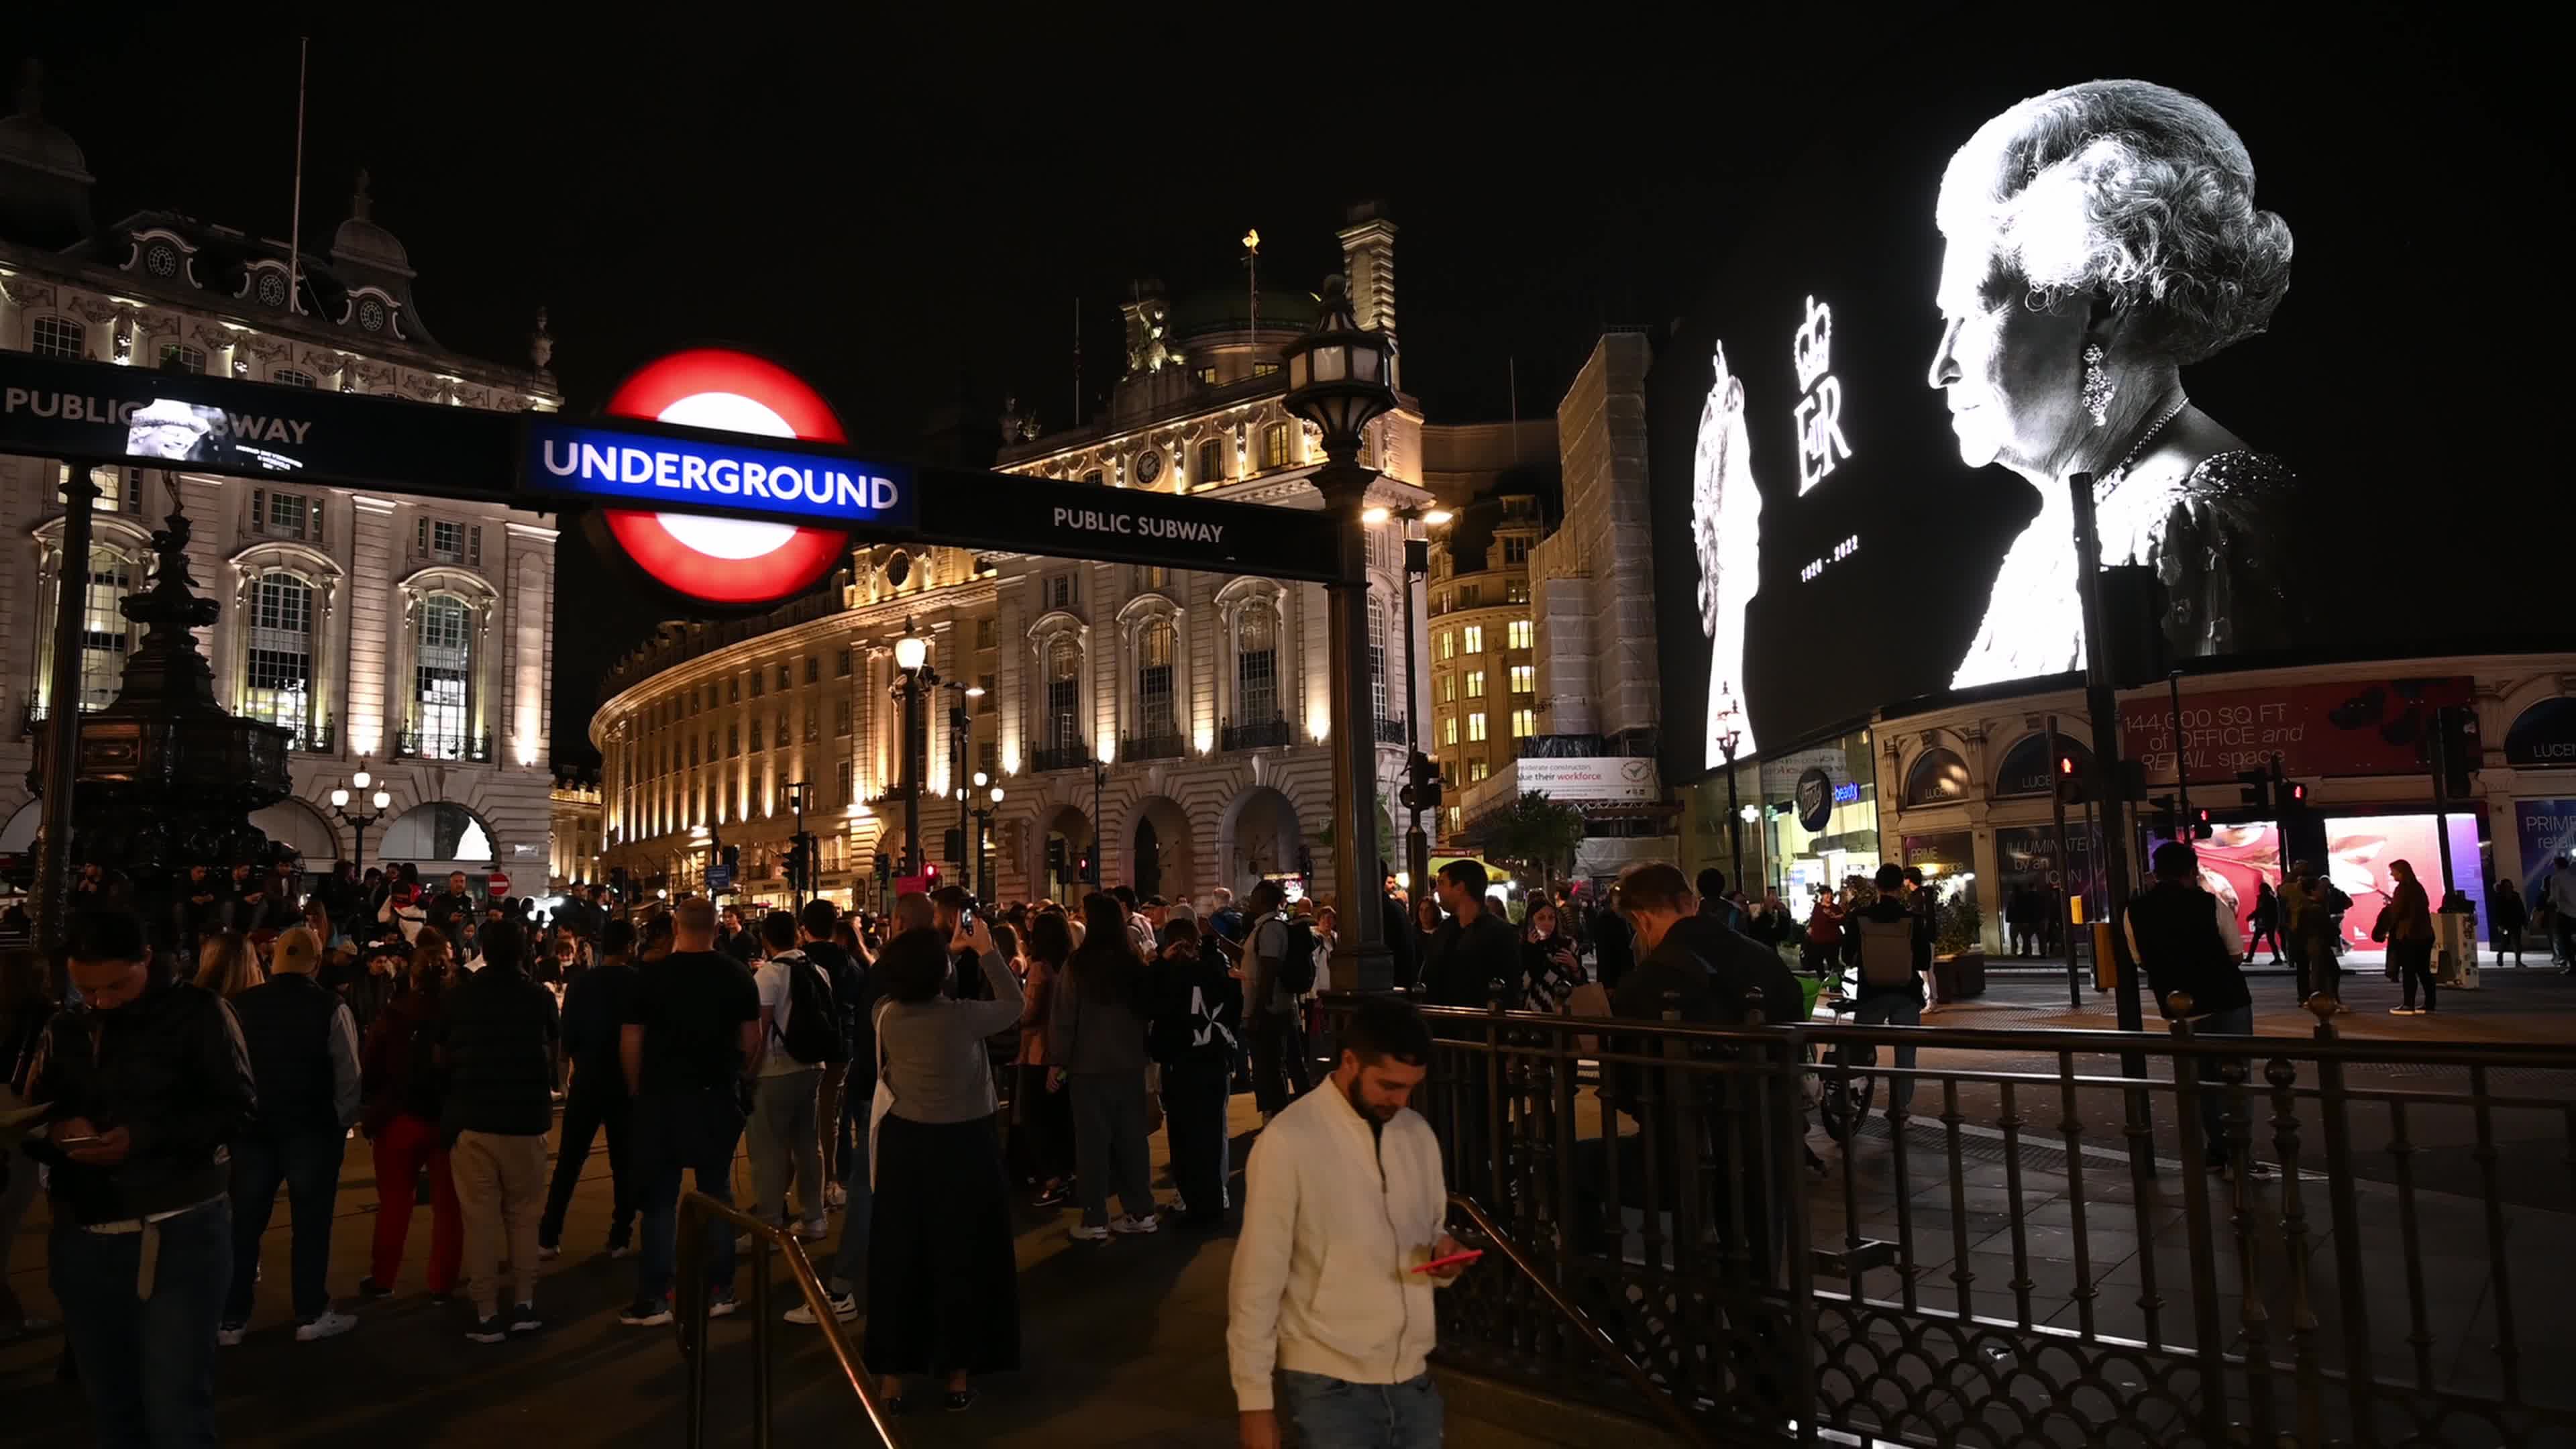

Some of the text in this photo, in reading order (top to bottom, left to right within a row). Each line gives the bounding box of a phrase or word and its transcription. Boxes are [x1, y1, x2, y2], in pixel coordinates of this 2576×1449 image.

[544, 439, 899, 510] UNDERGROUND
[1053, 507, 1224, 543] PUBLIC SUBWAY
[2218, 705, 2253, 725] SQ
[2259, 703, 2287, 722] FT
[2149, 732, 2169, 751] of
[2261, 722, 2305, 743] and
[1535, 772, 1556, 781] their
[1557, 772, 1601, 781] workforce
